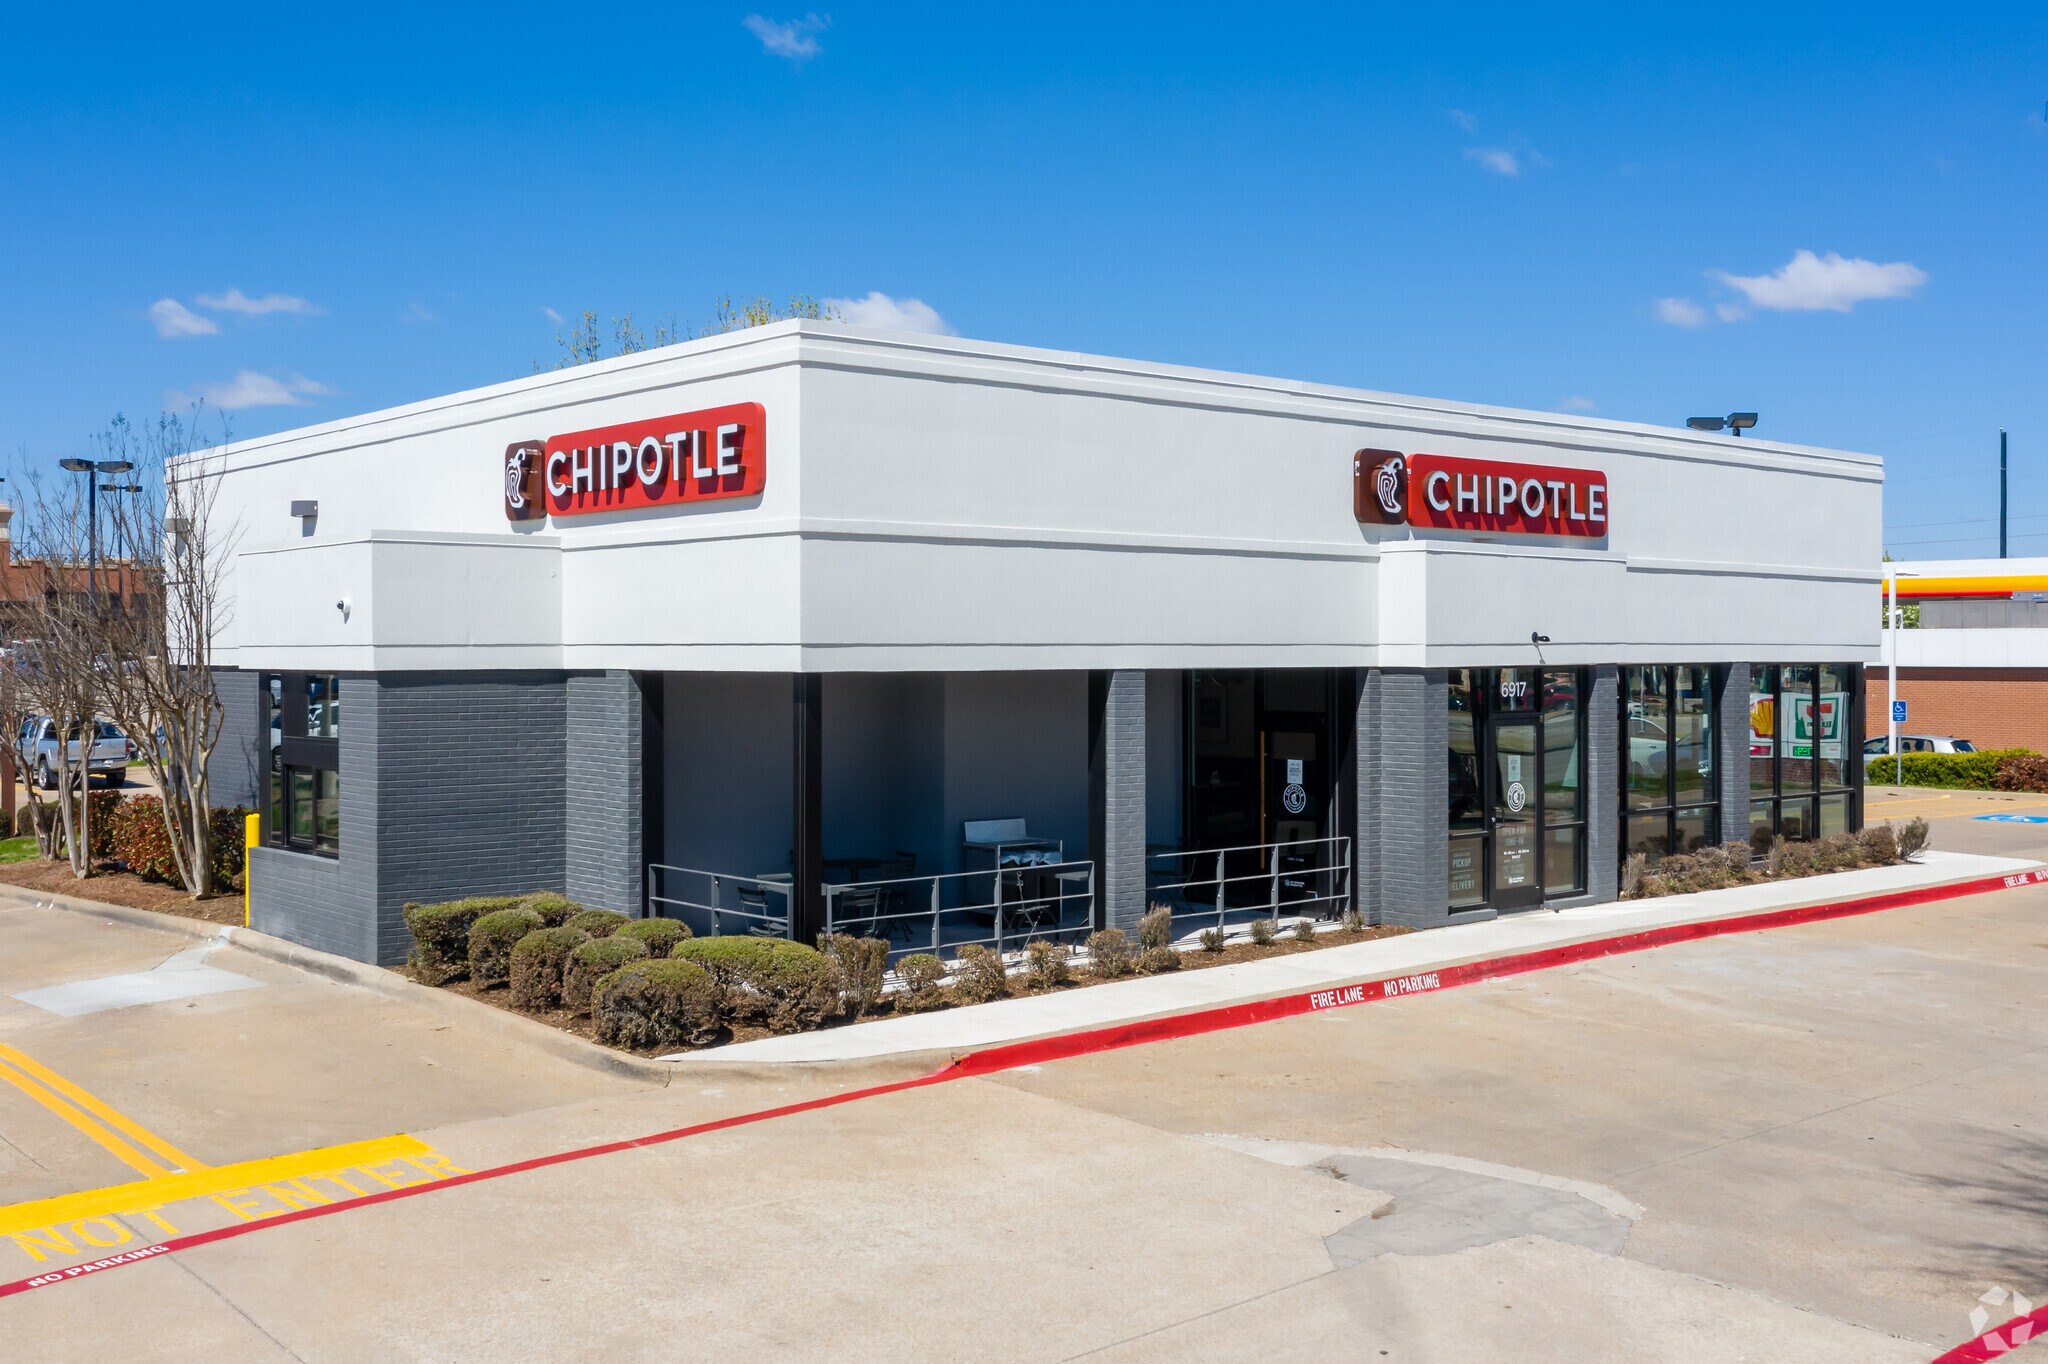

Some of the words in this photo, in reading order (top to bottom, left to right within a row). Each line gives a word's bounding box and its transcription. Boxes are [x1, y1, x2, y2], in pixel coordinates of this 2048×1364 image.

[547, 423, 738, 497] CHIPOTLE
[1428, 470, 1605, 521] CHIPOTLE
[1501, 681, 1527, 697] 6917
[1452, 857, 1472, 869] PICKUP
[1310, 991, 1336, 1010] FIRE
[1336, 986, 1365, 1005] LANE
[1383, 981, 1398, 997] NO
[1399, 973, 1440, 995] PARKING
[9, 1204, 182, 1262] NOT
[208, 1152, 478, 1221] ENTER
[27, 1273, 63, 1287] NO
[64, 1245, 170, 1276] PARKING
